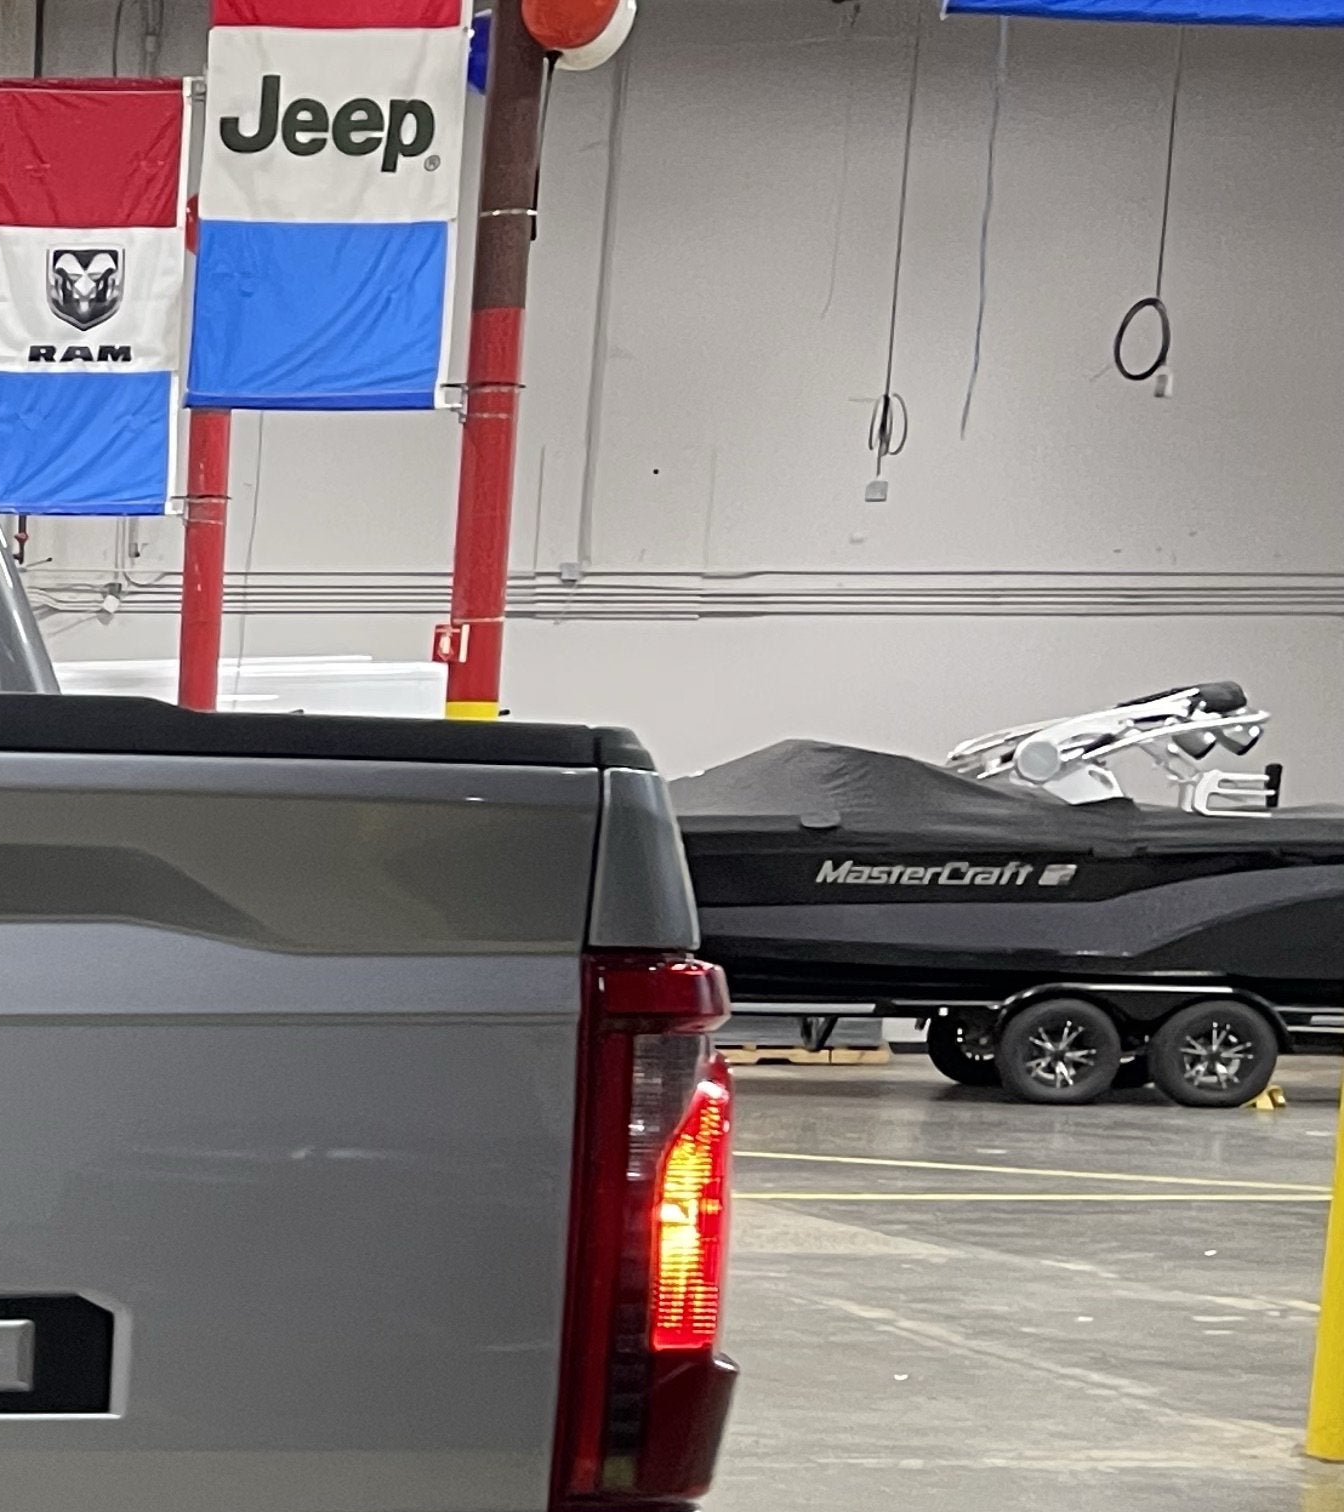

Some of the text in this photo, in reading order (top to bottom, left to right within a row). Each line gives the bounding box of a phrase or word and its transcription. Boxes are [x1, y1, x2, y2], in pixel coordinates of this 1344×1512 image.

[219, 75, 436, 172] Jeep
[28, 345, 132, 362] RAM
[815, 860, 1034, 886] MasterCraft
